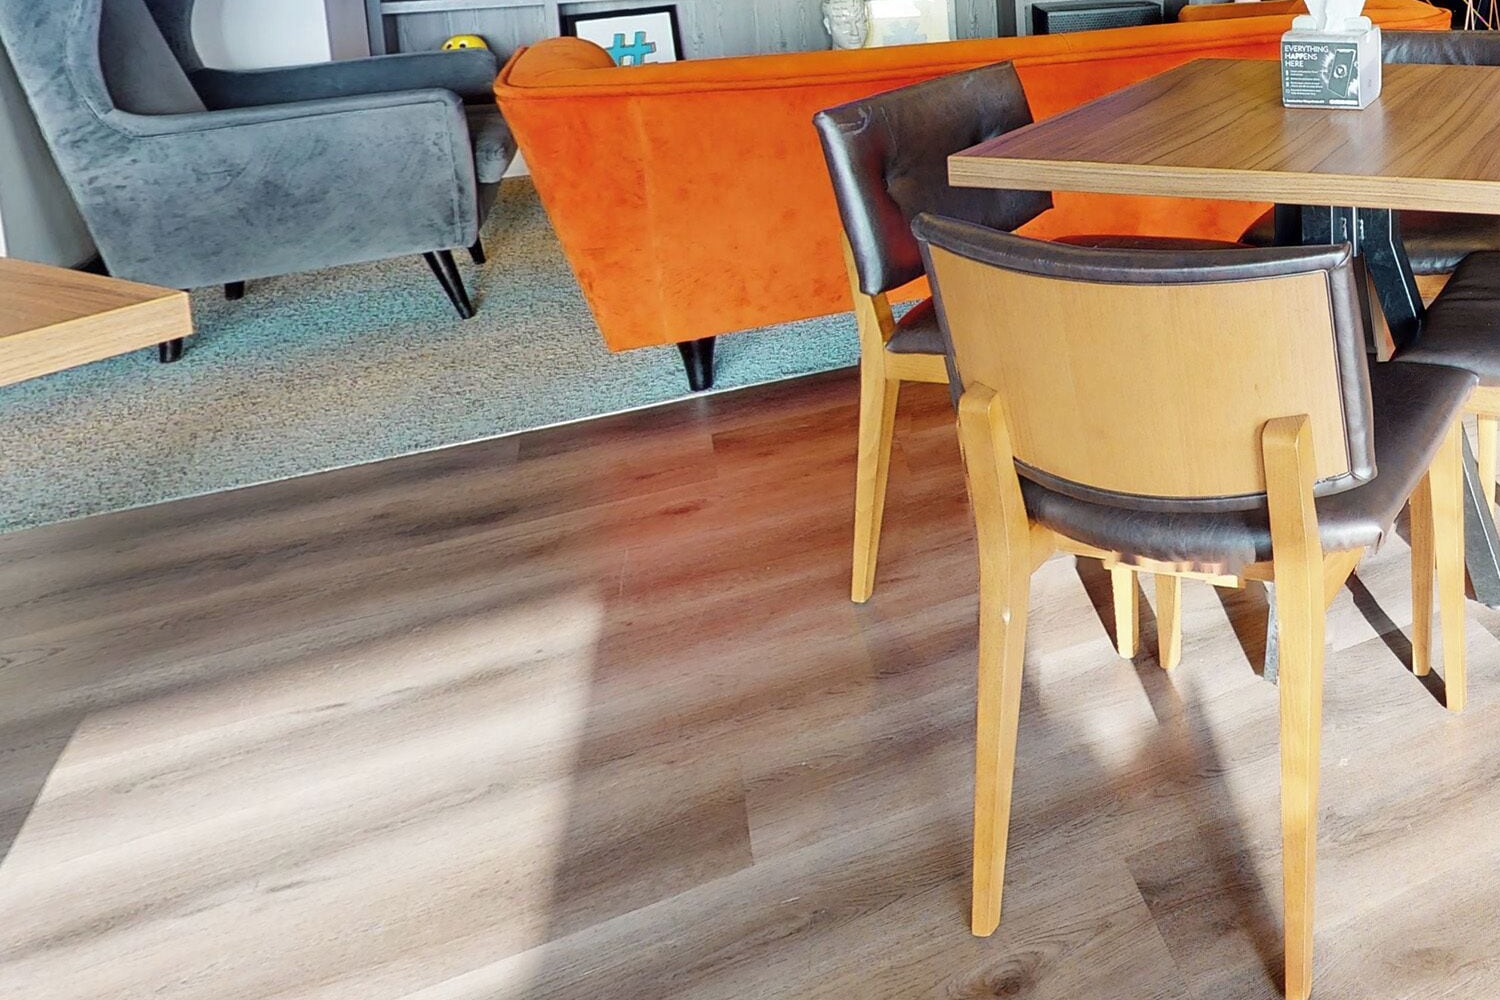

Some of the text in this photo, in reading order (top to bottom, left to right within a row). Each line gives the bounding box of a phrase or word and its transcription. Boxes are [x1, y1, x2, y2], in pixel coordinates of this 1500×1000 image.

[1284, 44, 1329, 53] EVERYTHING
[1284, 52, 1318, 60] HAPPENS
[1285, 60, 1304, 68] HERE
